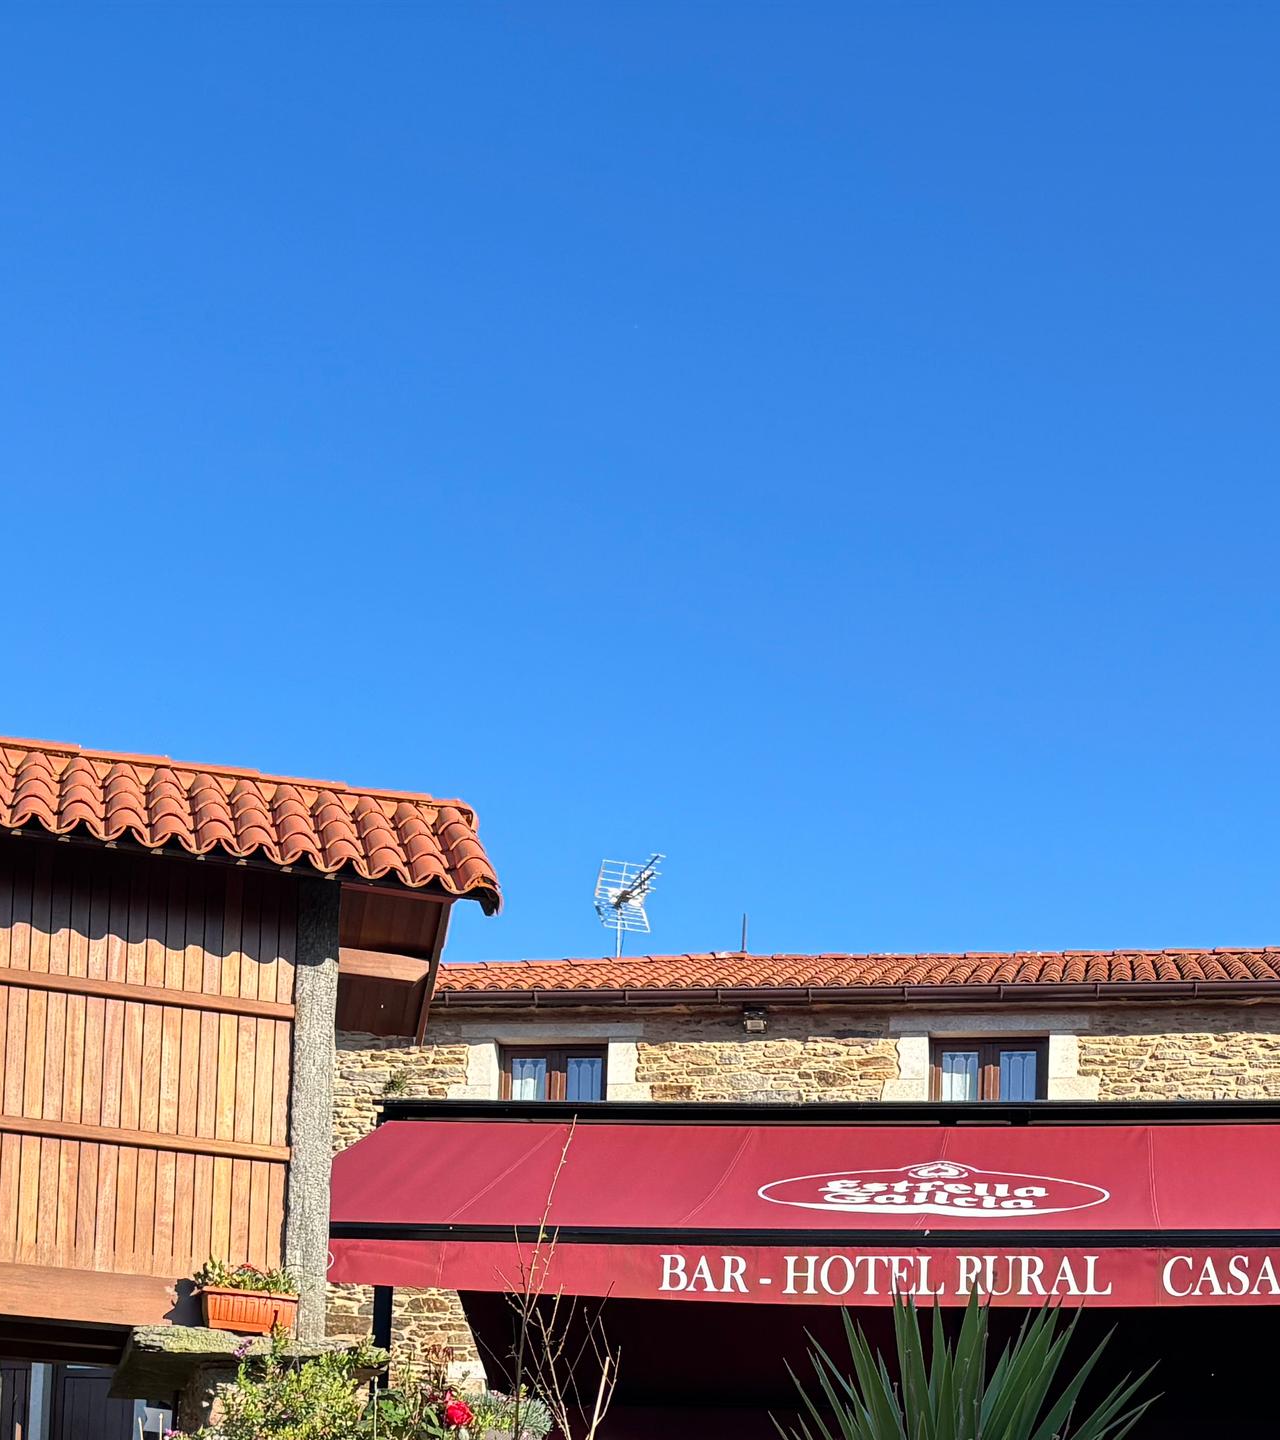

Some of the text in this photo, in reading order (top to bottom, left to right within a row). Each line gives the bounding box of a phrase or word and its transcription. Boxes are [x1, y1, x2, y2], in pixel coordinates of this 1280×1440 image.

[817, 1180, 1049, 1198] Estrella
[823, 1190, 1037, 1209] Galicia
[658, 1253, 749, 1293] BAR
[781, 1254, 945, 1296] HOTEL
[955, 1255, 1112, 1296] RURAL
